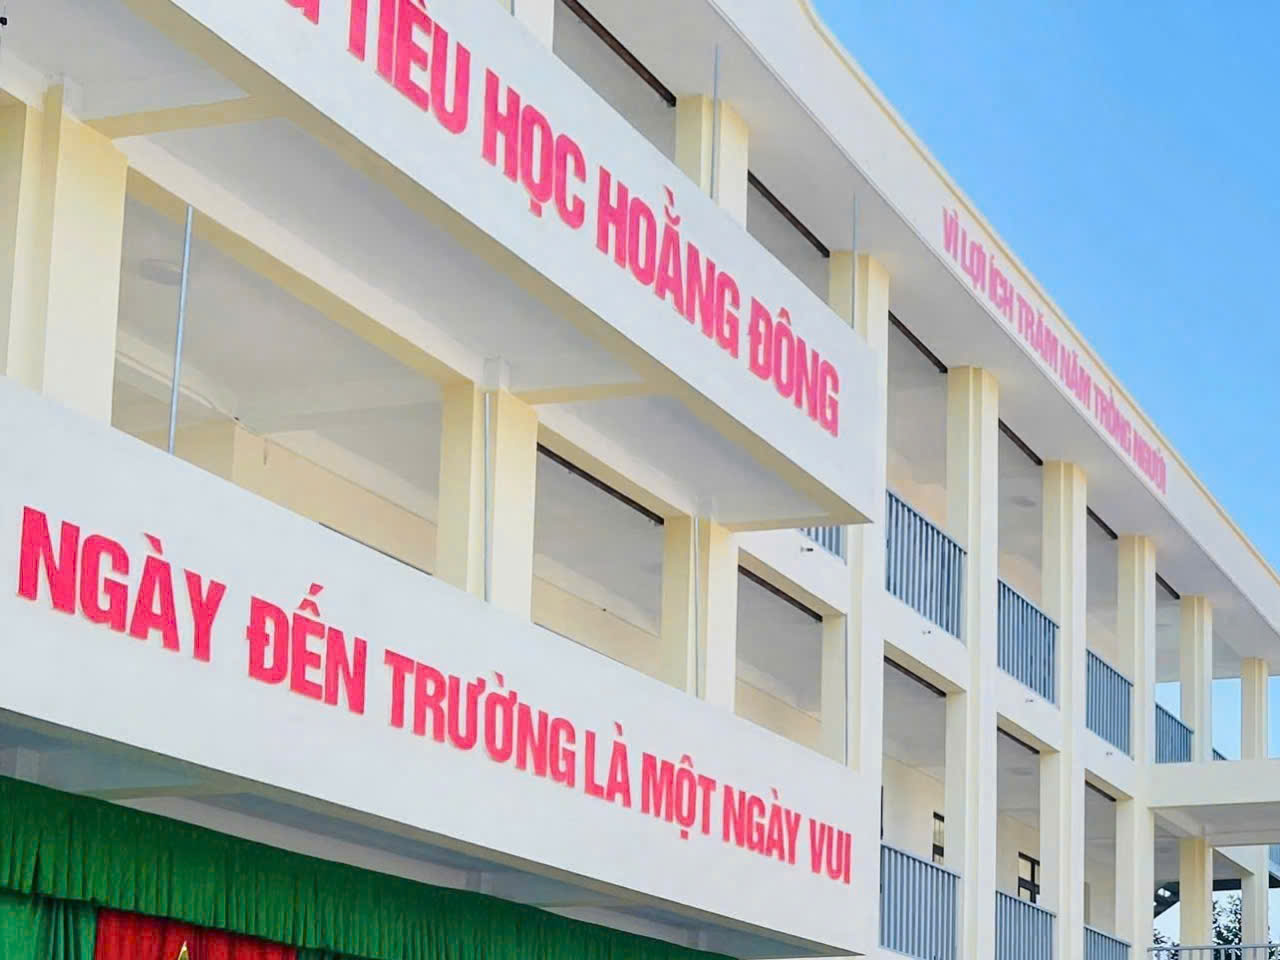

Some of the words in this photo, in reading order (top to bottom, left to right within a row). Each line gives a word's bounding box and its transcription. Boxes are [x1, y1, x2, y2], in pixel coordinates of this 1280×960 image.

[482, 67, 586, 230] HỌC
[596, 165, 740, 360] HOẰNG
[747, 296, 839, 438] ĐÔNG
[988, 254, 1014, 323] ÍCH
[16, 505, 227, 662] NGÀY
[246, 582, 367, 715] ĐẾN
[384, 648, 576, 788] TRƯỜNG
[583, 721, 631, 808] LÀ
[640, 751, 717, 839] MỘT
[722, 787, 802, 865] NGÀY
[809, 818, 852, 885] VUI
